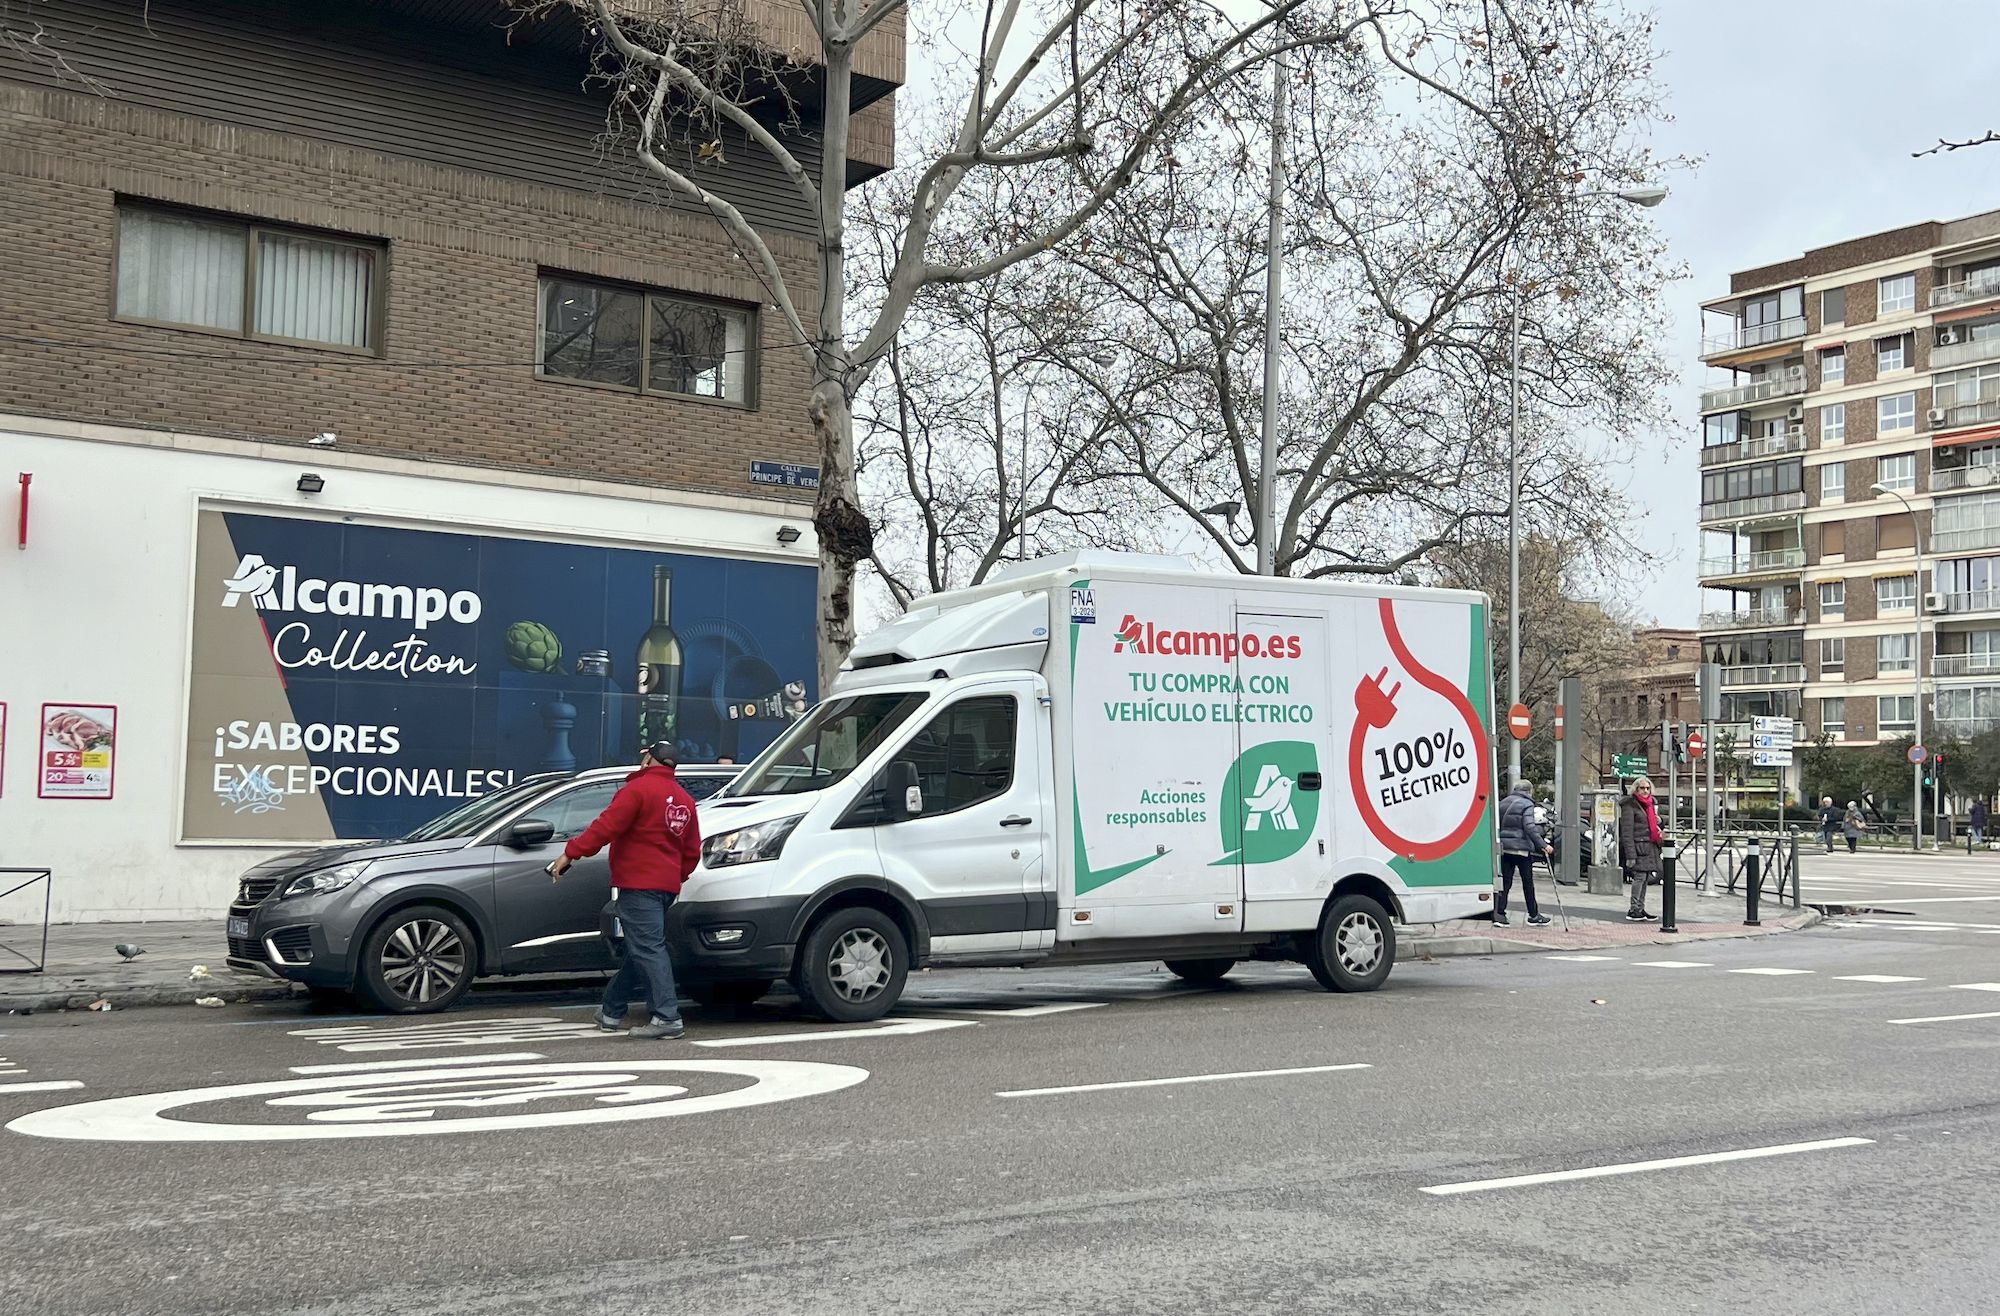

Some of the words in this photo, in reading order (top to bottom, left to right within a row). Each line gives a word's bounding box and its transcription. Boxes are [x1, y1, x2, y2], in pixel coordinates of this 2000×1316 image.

[752, 471, 783, 484] PRINCIPE
[786, 475, 796, 485] DE
[781, 465, 802, 473] CALLE
[222, 554, 482, 629] Alcampo
[1071, 590, 1094, 606] FNA
[273, 622, 478, 679] Collection
[1114, 615, 1301, 663] Alcampo.es
[1129, 672, 1157, 692] TU
[1162, 673, 1245, 693] COMPRA
[1249, 675, 1289, 694] CON
[1104, 697, 1207, 722] VEHÍCULO
[215, 720, 401, 758] ¡SABORES
[1375, 728, 1465, 780] 100%
[213, 763, 514, 799] EXCEPCIONALES!
[1140, 787, 1206, 805] Acciones
[1380, 766, 1470, 808] ELÉCTRICO
[1106, 807, 1207, 829] responsables
[265, 1074, 689, 1122] 30
